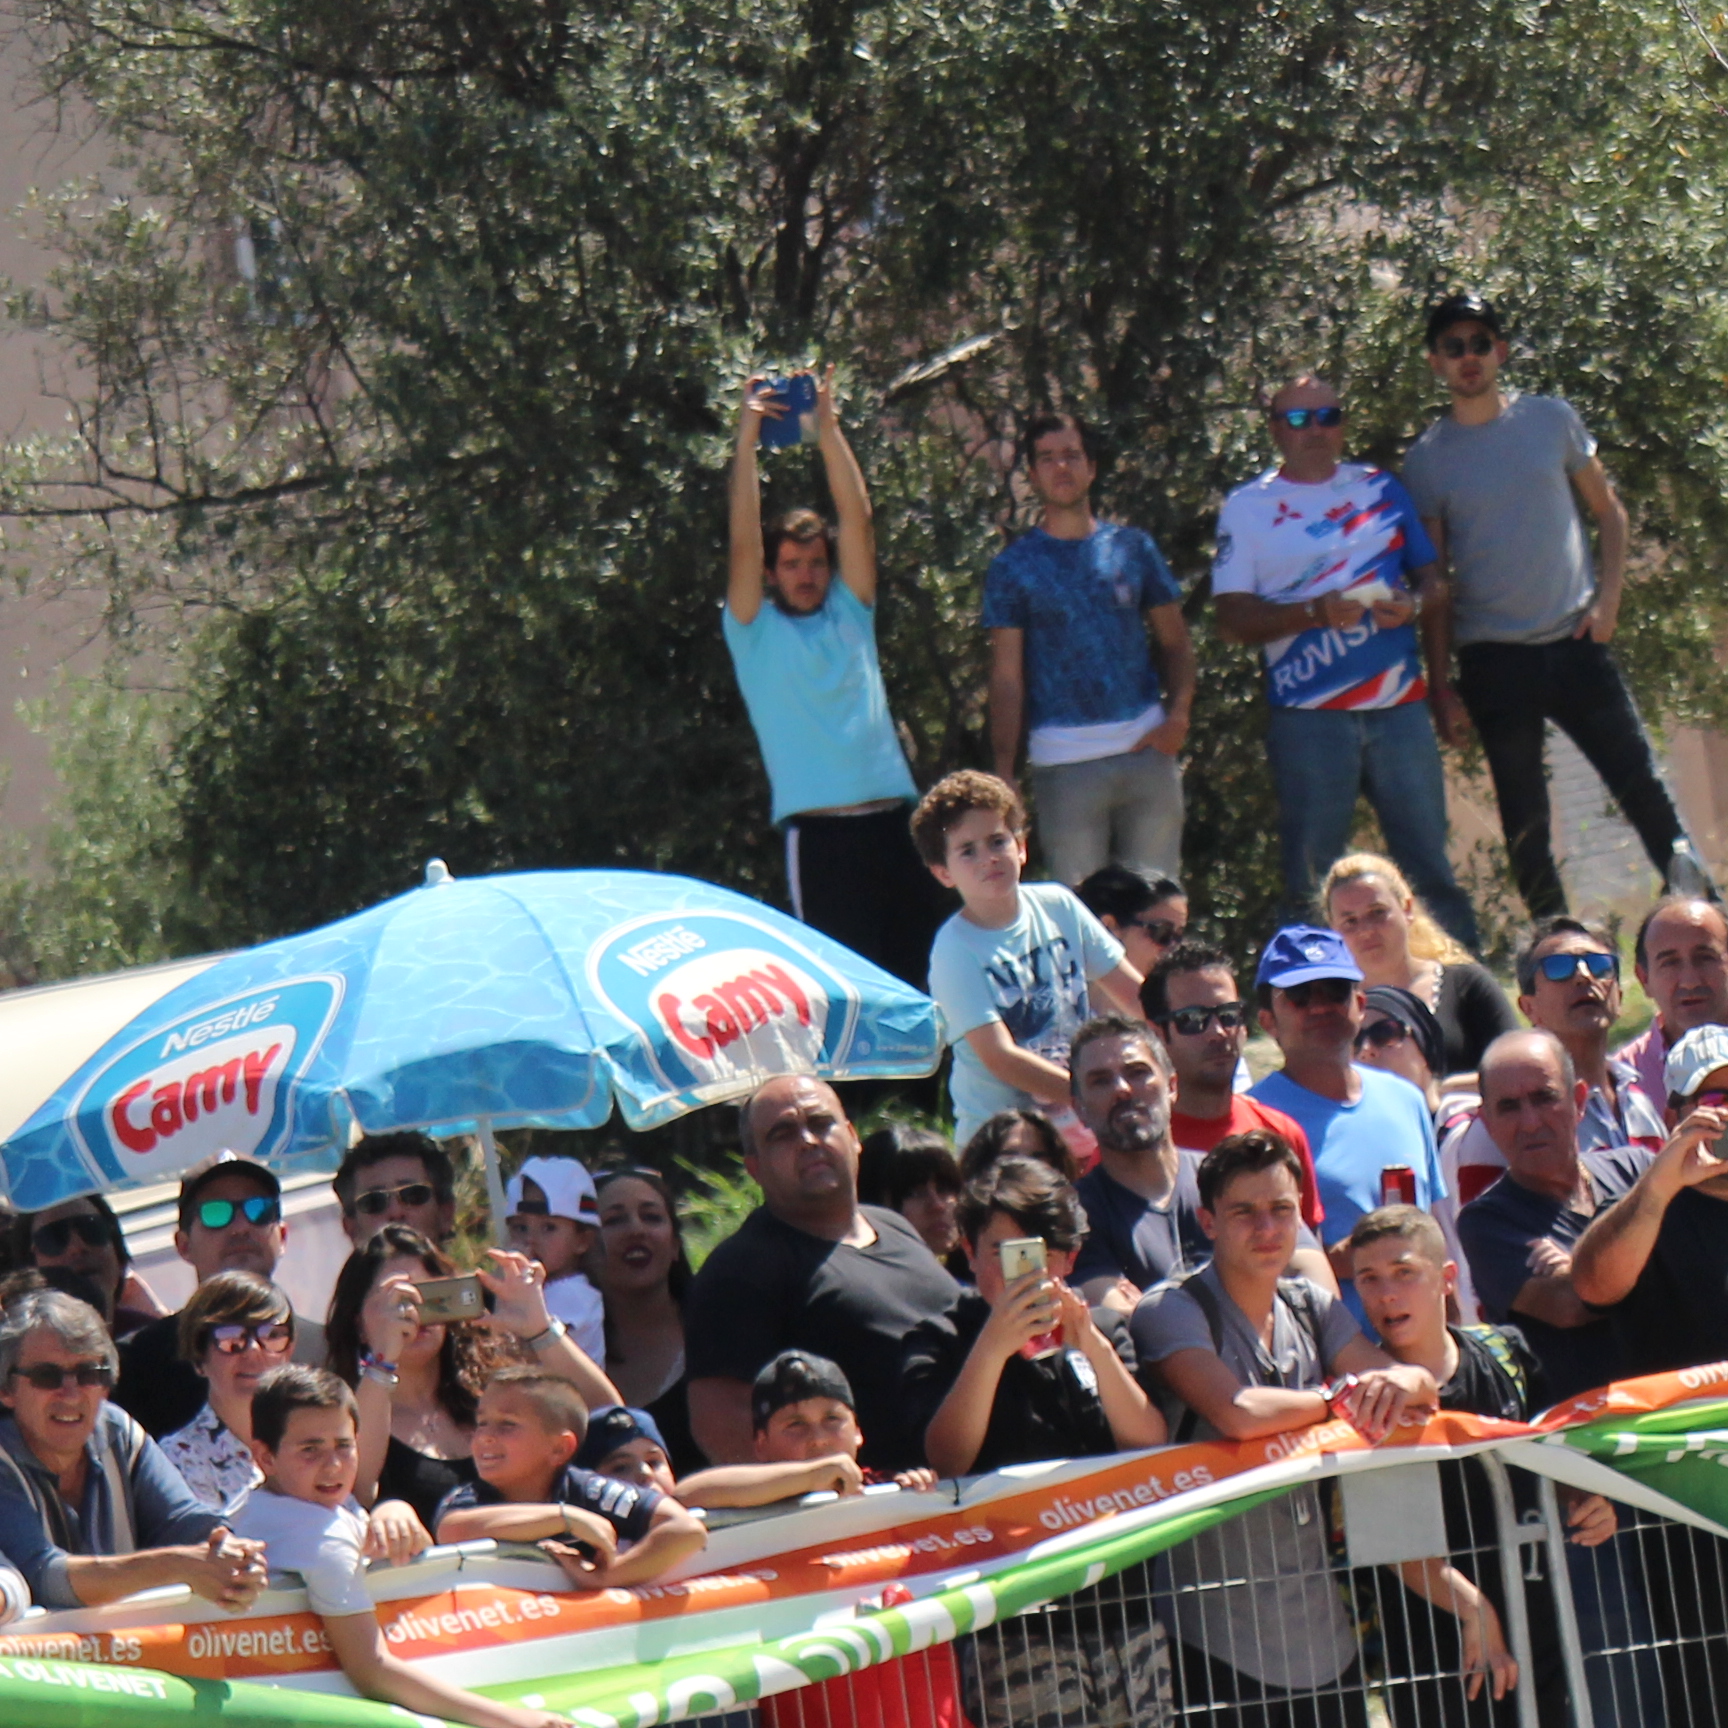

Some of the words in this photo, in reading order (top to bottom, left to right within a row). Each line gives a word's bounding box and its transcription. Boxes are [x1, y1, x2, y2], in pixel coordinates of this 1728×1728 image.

[616, 925, 707, 979] Nestlé
[159, 994, 279, 1058] Nestlé
[648, 960, 813, 1060] Camy
[111, 1042, 282, 1155] Camy
[1038, 1461, 1214, 1531] olivenet.es
[385, 1595, 561, 1643] olivenet.es
[15, 1661, 167, 1700] OLIVENET
